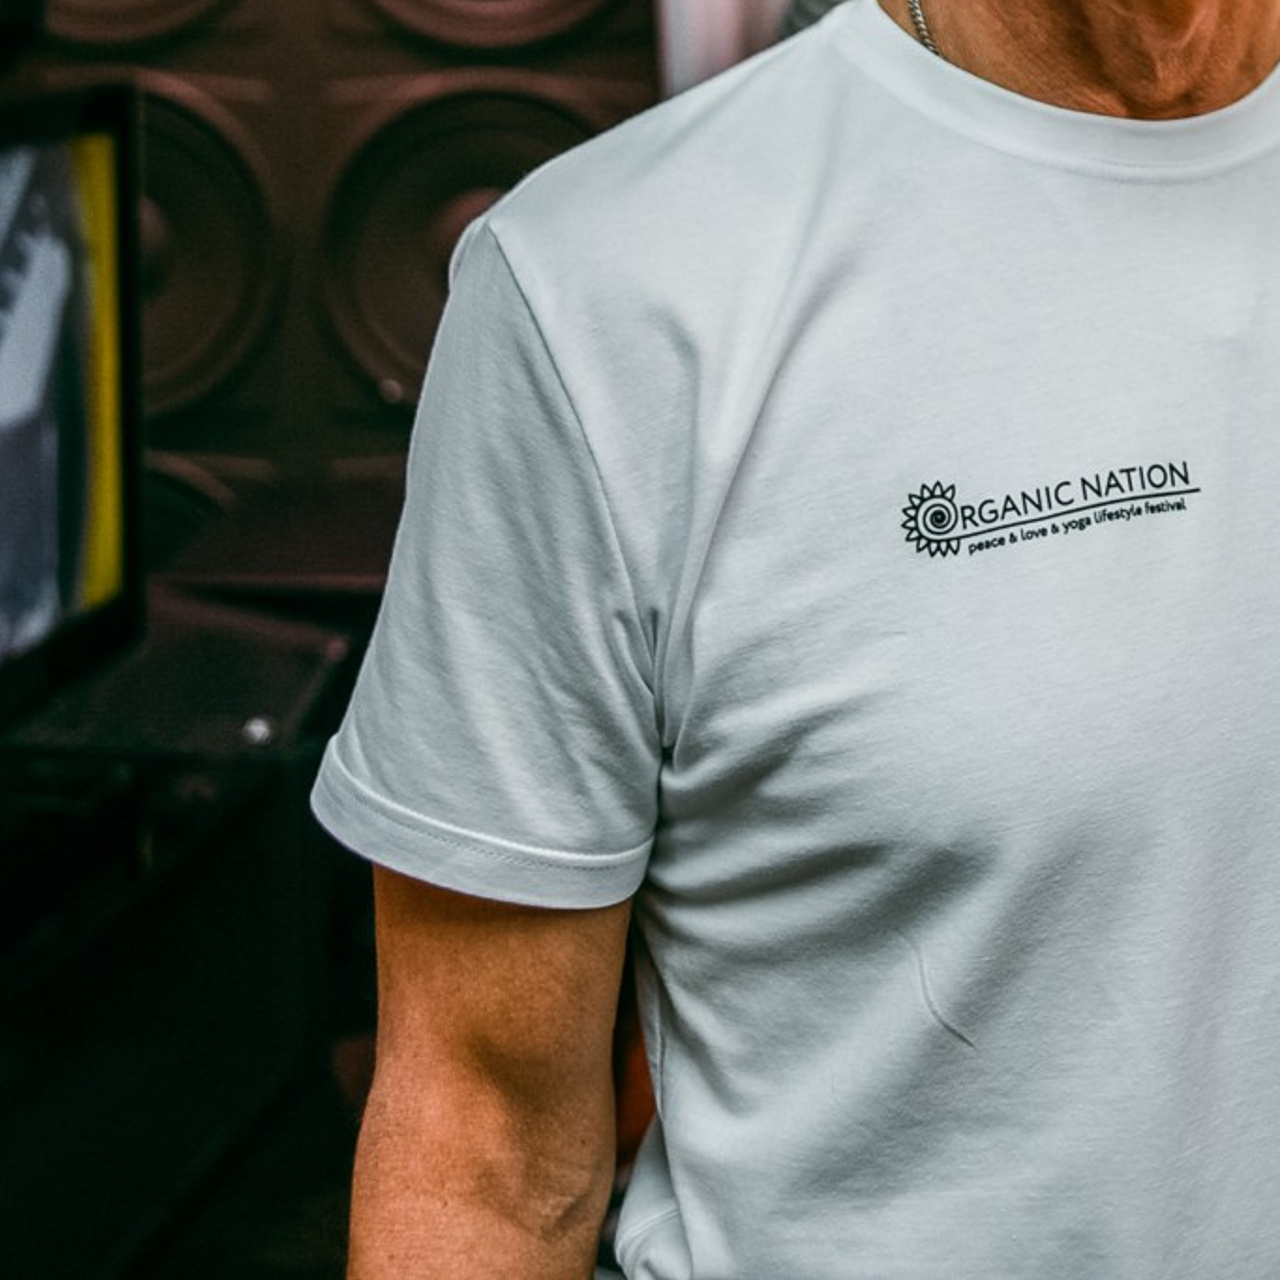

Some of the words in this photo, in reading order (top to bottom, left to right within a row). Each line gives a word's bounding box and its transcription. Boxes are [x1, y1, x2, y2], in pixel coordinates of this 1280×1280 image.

[1080, 460, 1190, 501] NATION
[968, 536, 1006, 556] peace
[1008, 532, 1018, 544] &
[1020, 527, 1048, 541] love
[1051, 522, 1060, 535] &
[1061, 516, 1092, 535] yoga
[1093, 503, 1143, 524] lifestyle
[1144, 496, 1187, 514] festival
